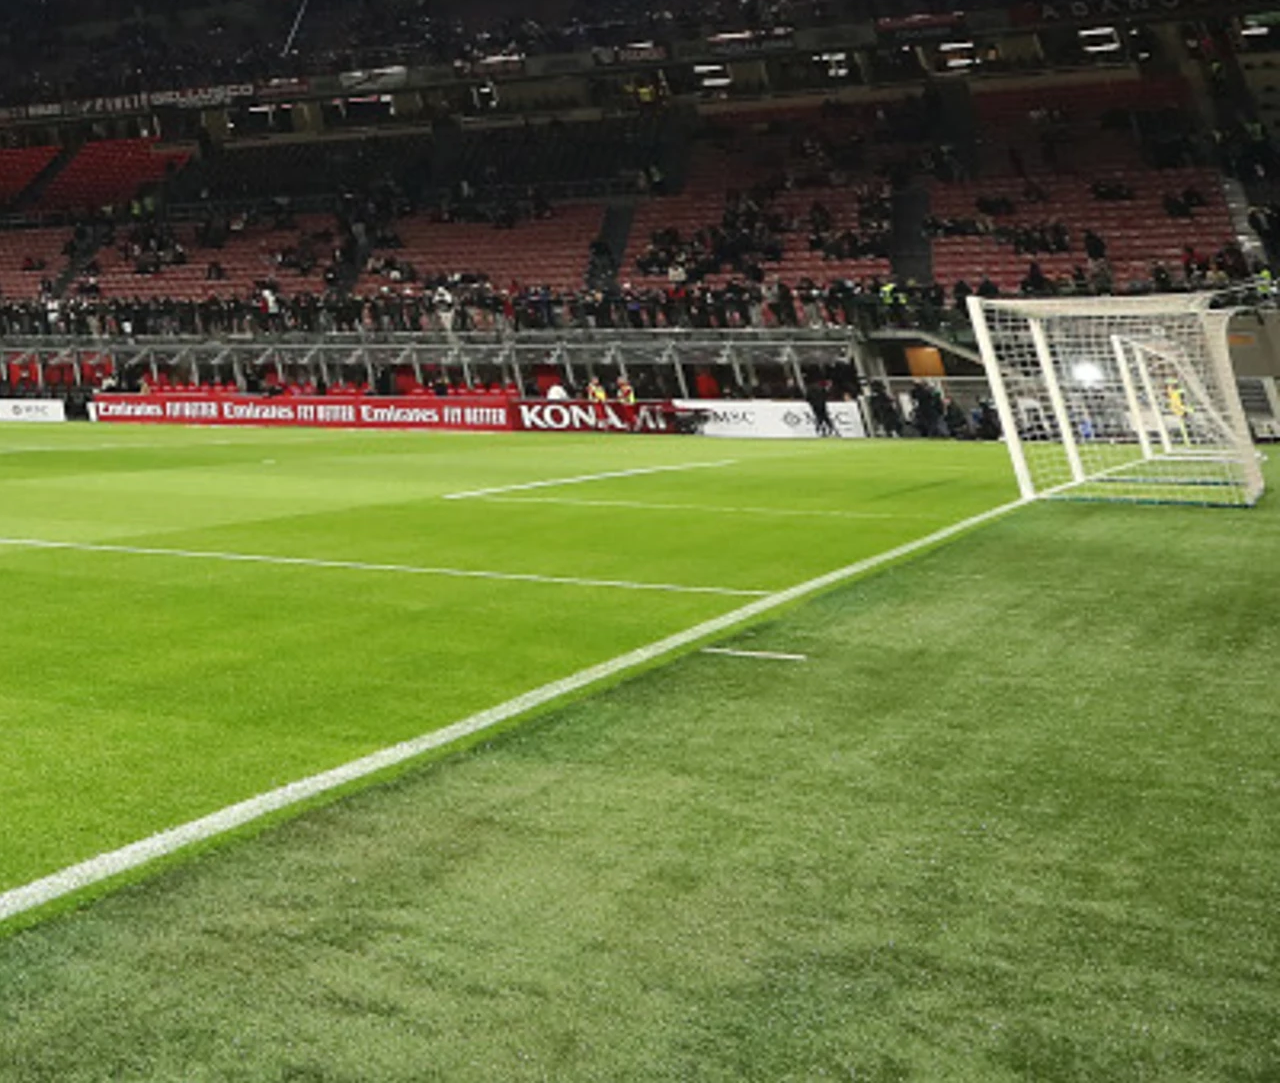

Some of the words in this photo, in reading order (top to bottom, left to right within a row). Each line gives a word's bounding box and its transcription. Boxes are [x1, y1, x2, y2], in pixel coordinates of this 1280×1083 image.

[99, 402, 163, 417] Emirates
[223, 402, 295, 419] Emirates
[360, 405, 439, 423] Emirates
